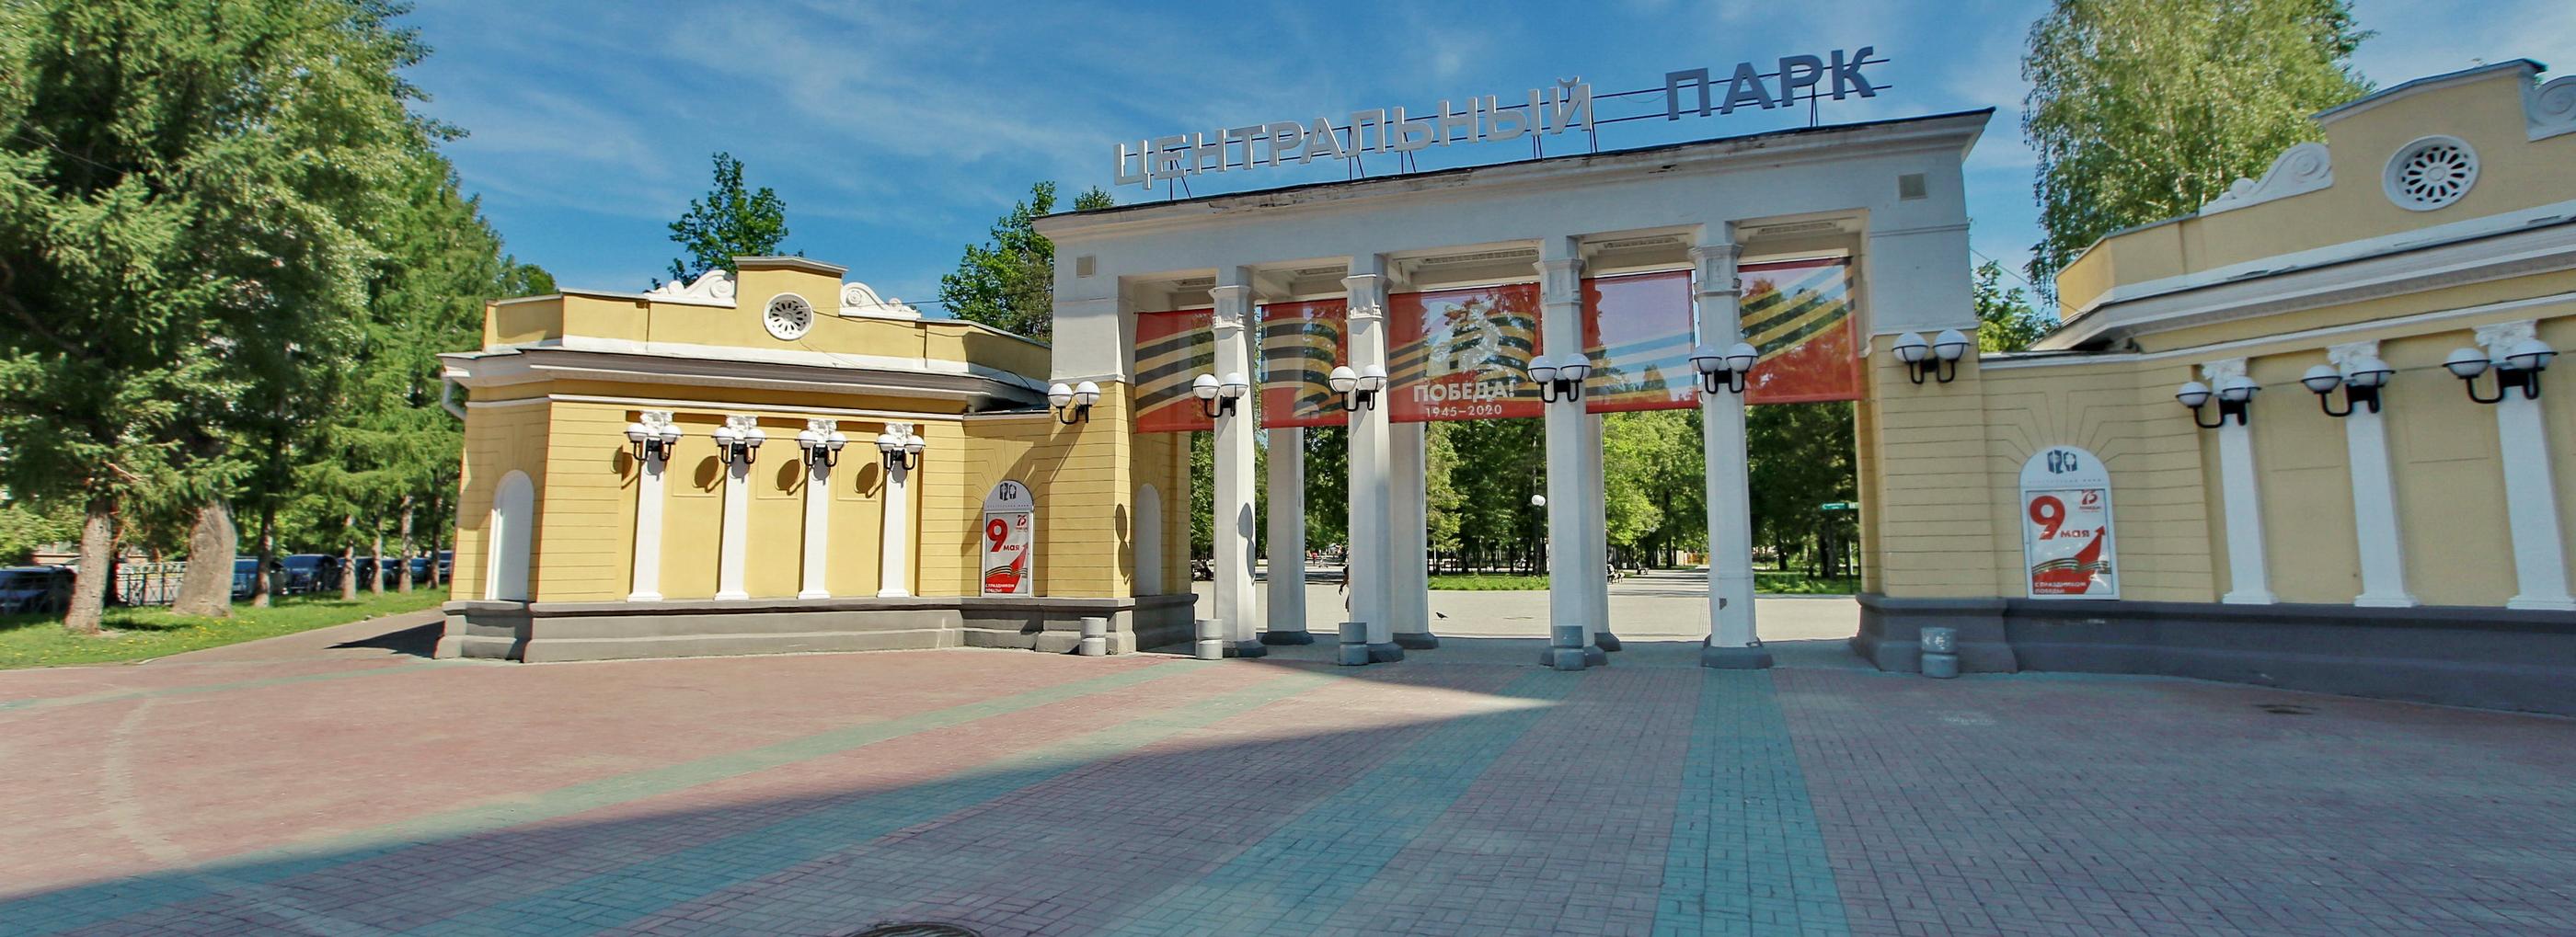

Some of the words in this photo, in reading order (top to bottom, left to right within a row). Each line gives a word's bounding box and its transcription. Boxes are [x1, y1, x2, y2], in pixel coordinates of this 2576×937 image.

[1113, 75, 1593, 189] ЦЕНТРАЛЬНЫЙ
[1665, 45, 1878, 120] ПАРК
[1413, 382, 1515, 403] ПОБЕДА!
[986, 519, 1007, 552] 9
[2030, 496, 2065, 540] 9
